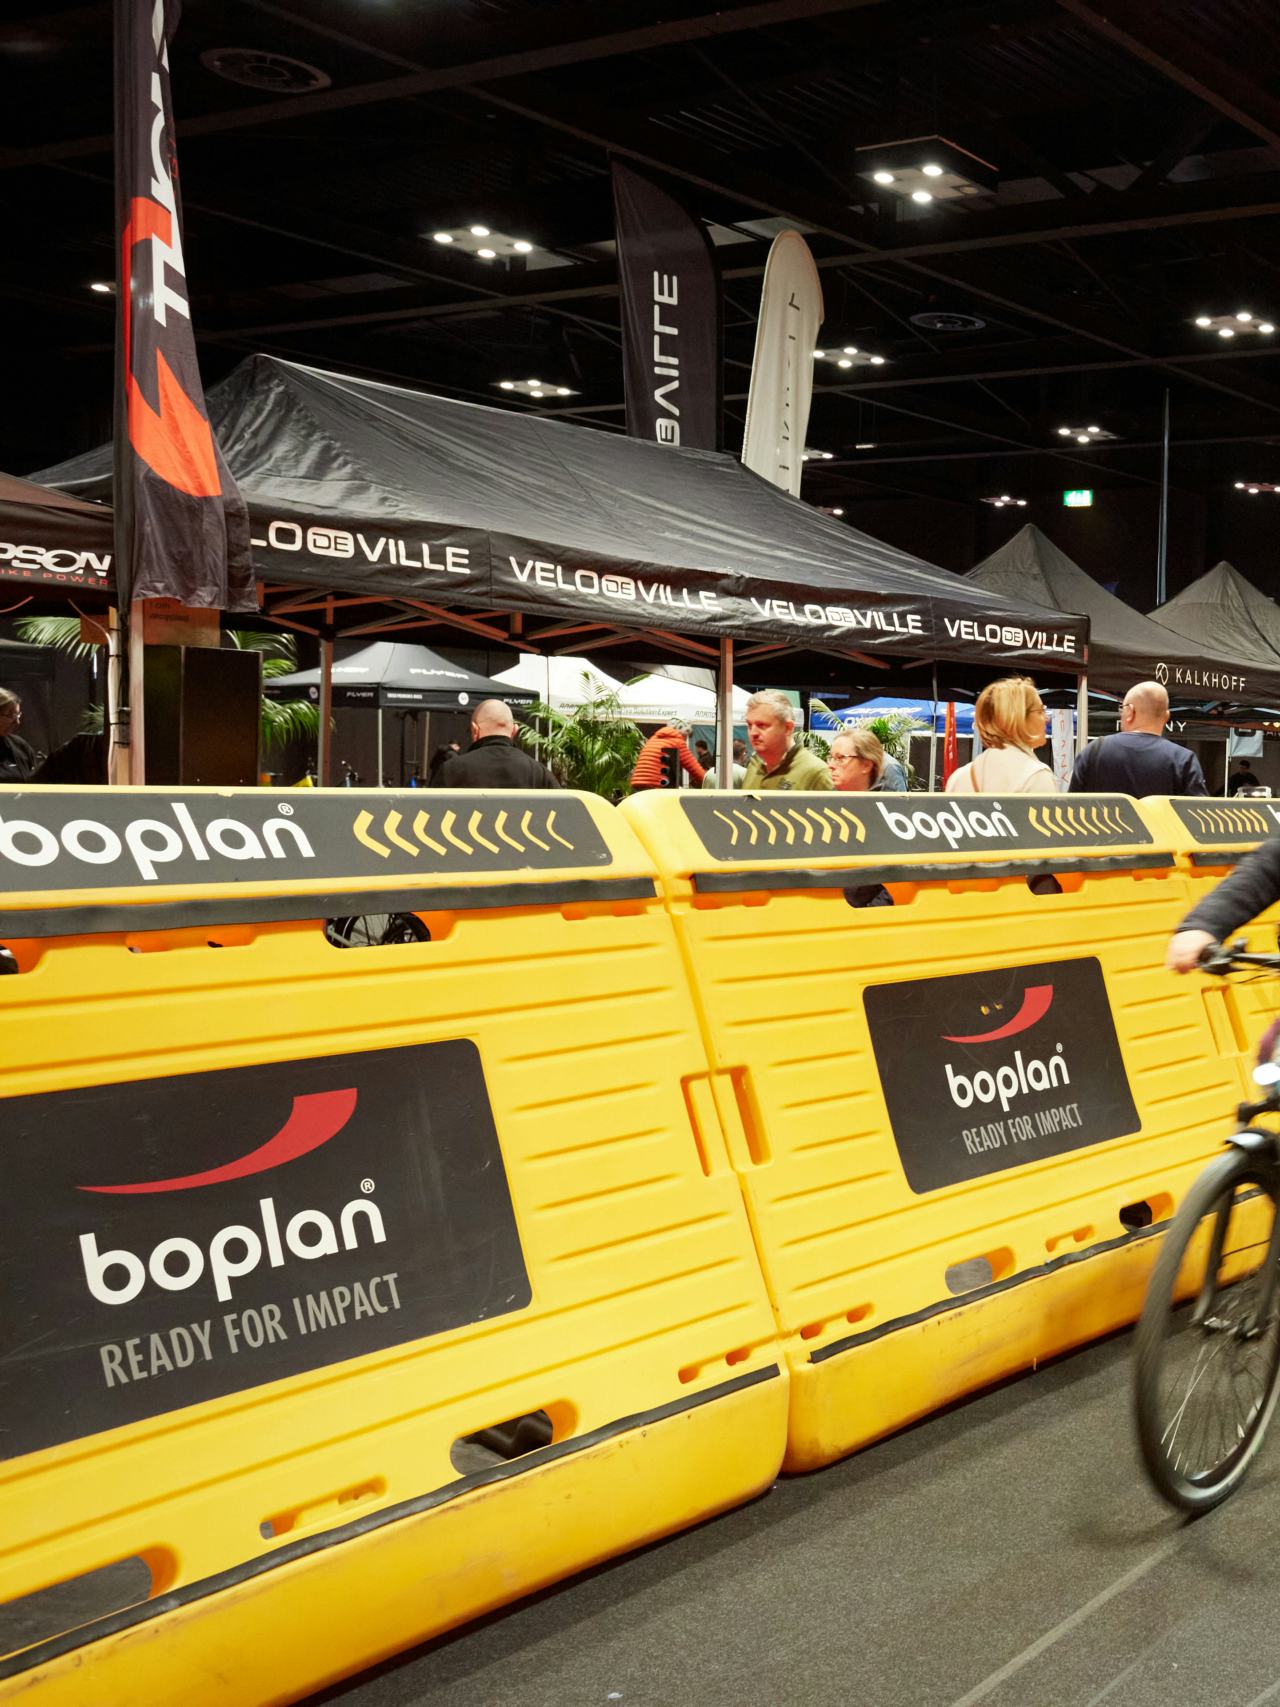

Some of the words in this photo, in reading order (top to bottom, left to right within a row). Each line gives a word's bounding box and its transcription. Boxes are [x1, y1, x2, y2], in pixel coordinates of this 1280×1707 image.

[42, 572, 110, 586] POWER
[1175, 667, 1247, 692] KALKHOFF
[961, 1122, 1008, 1155] READY
[1009, 1114, 1036, 1144] FOR
[1035, 1103, 1083, 1137] IMPACT
[100, 1319, 214, 1388] READY
[224, 1302, 289, 1354] FOR
[292, 1272, 402, 1335] IMPACT
